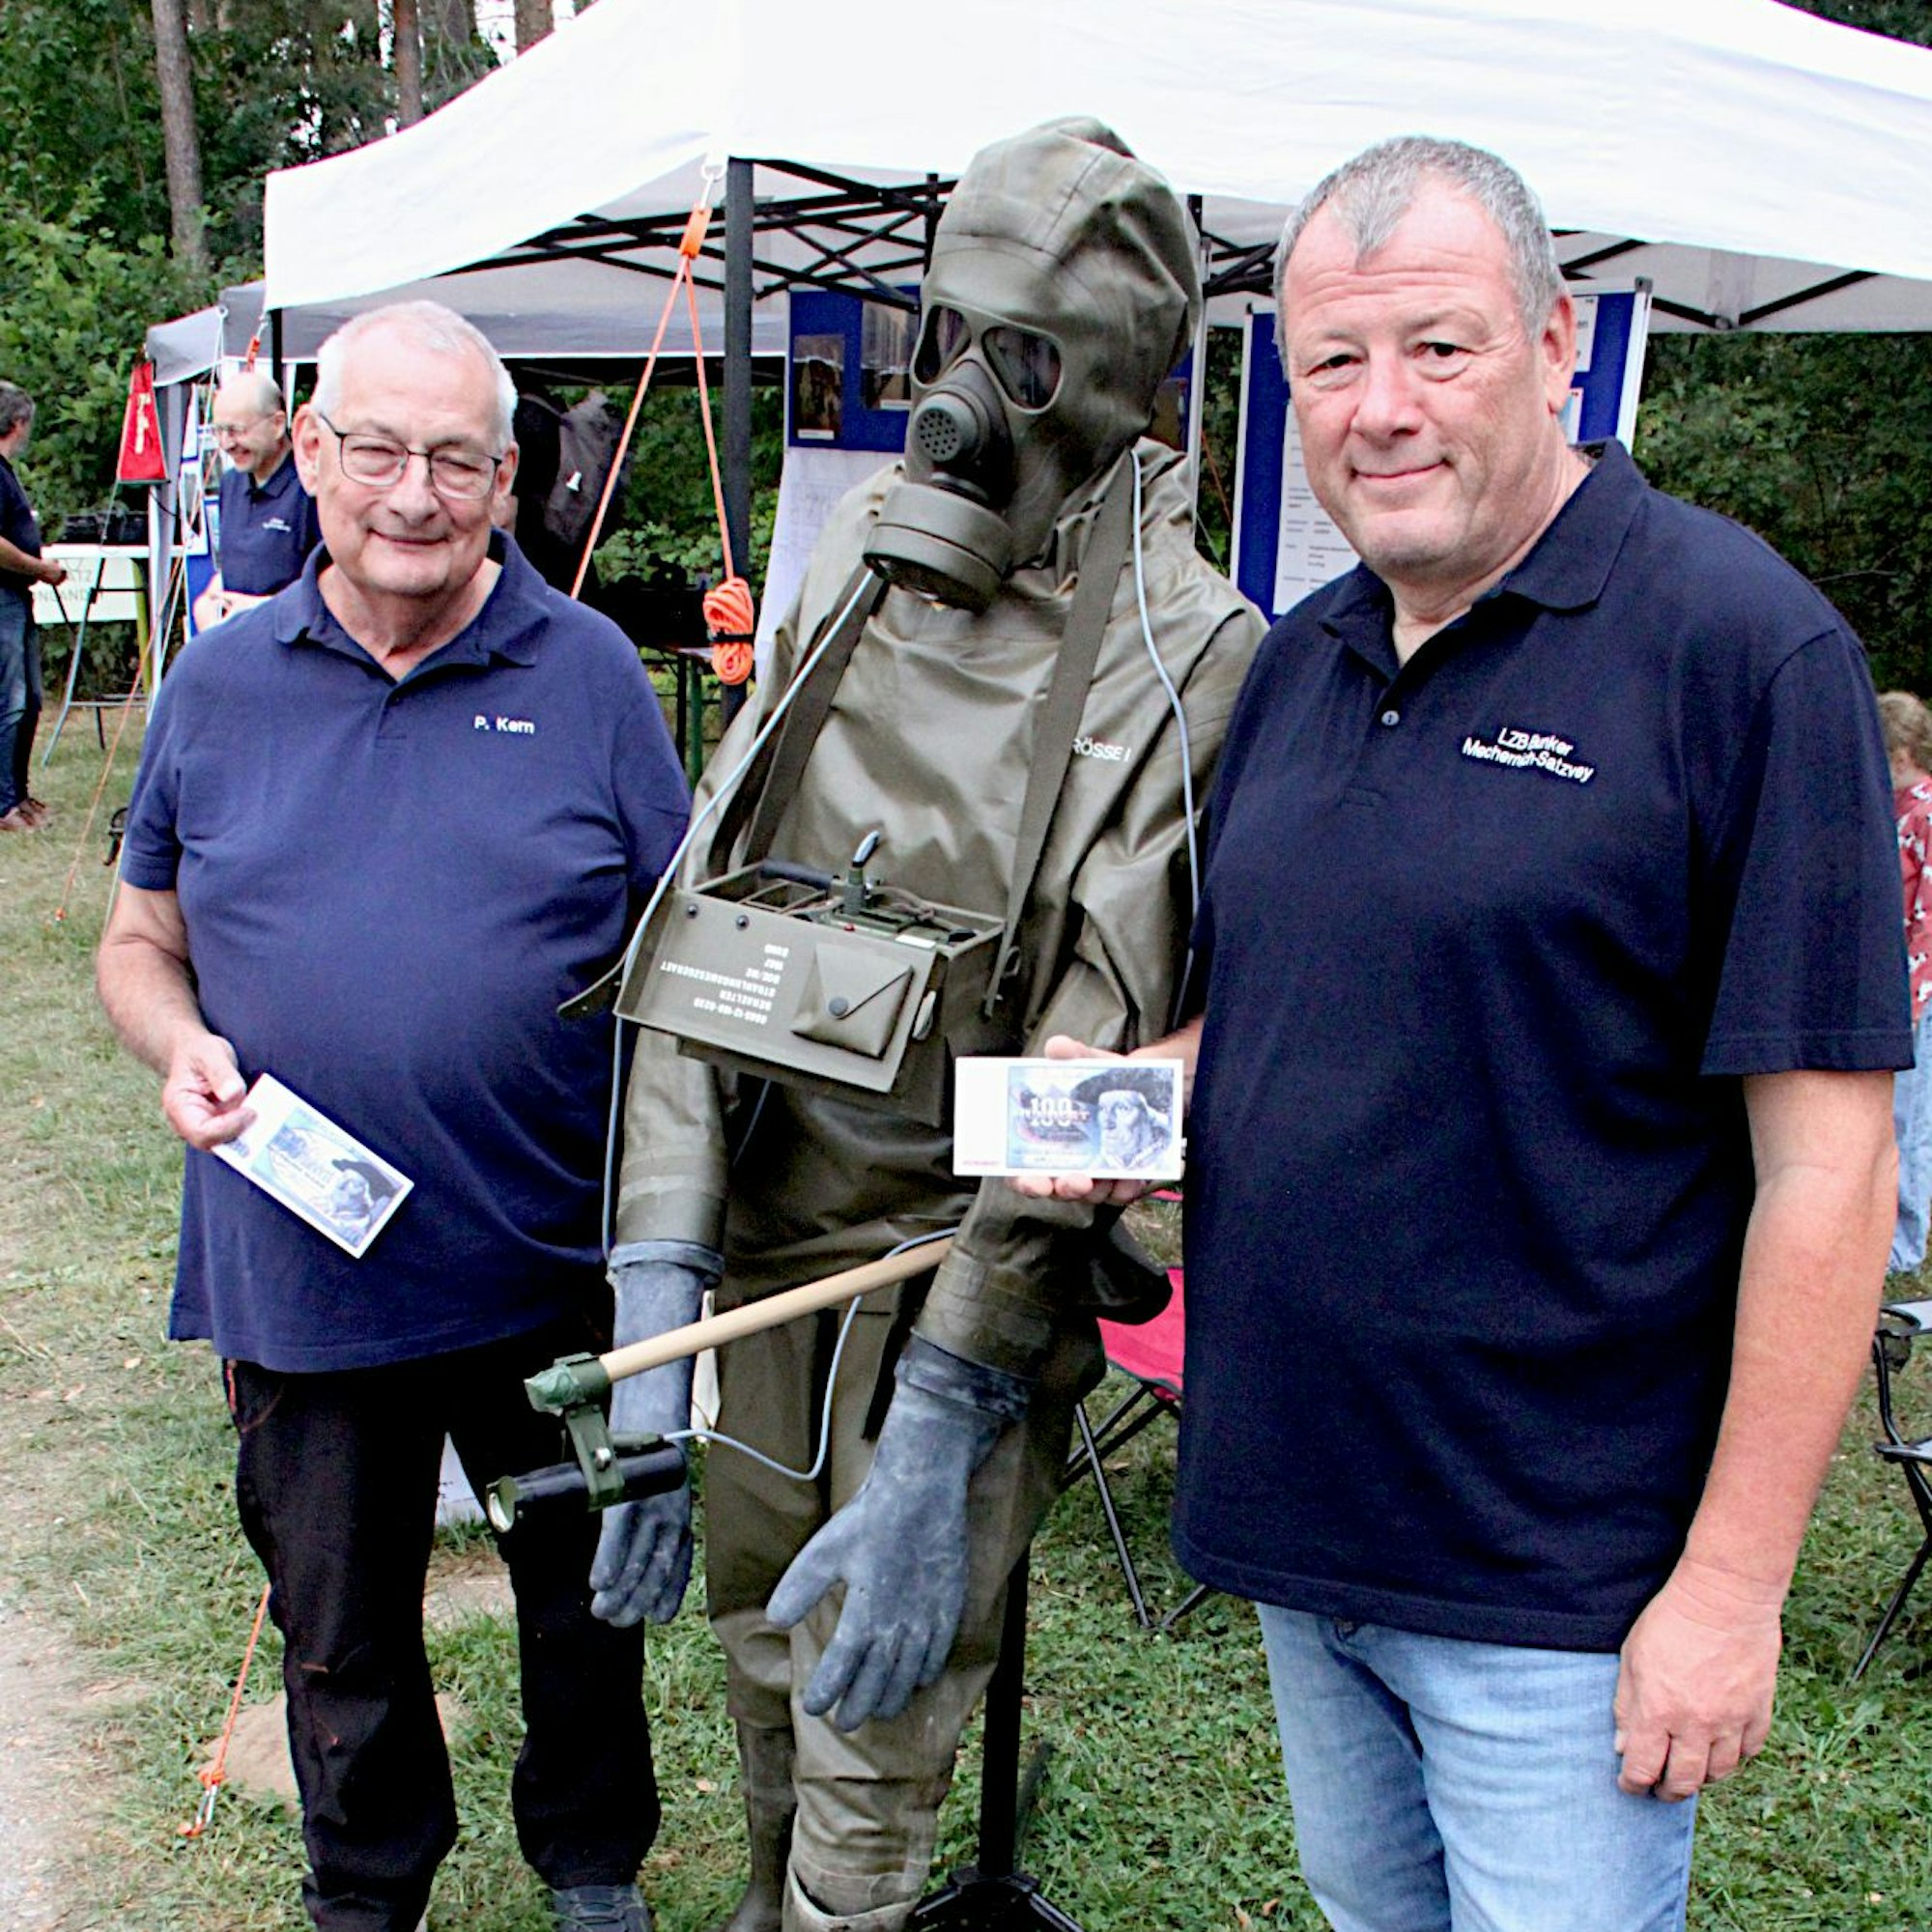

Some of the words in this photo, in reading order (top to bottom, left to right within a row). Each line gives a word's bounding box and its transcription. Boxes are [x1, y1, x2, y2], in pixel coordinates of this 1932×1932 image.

[474, 715, 490, 730] P.
[1071, 736, 1123, 761] RÖSSE
[1497, 726, 1529, 751] LZB
[1030, 1097, 1072, 1127] 100
